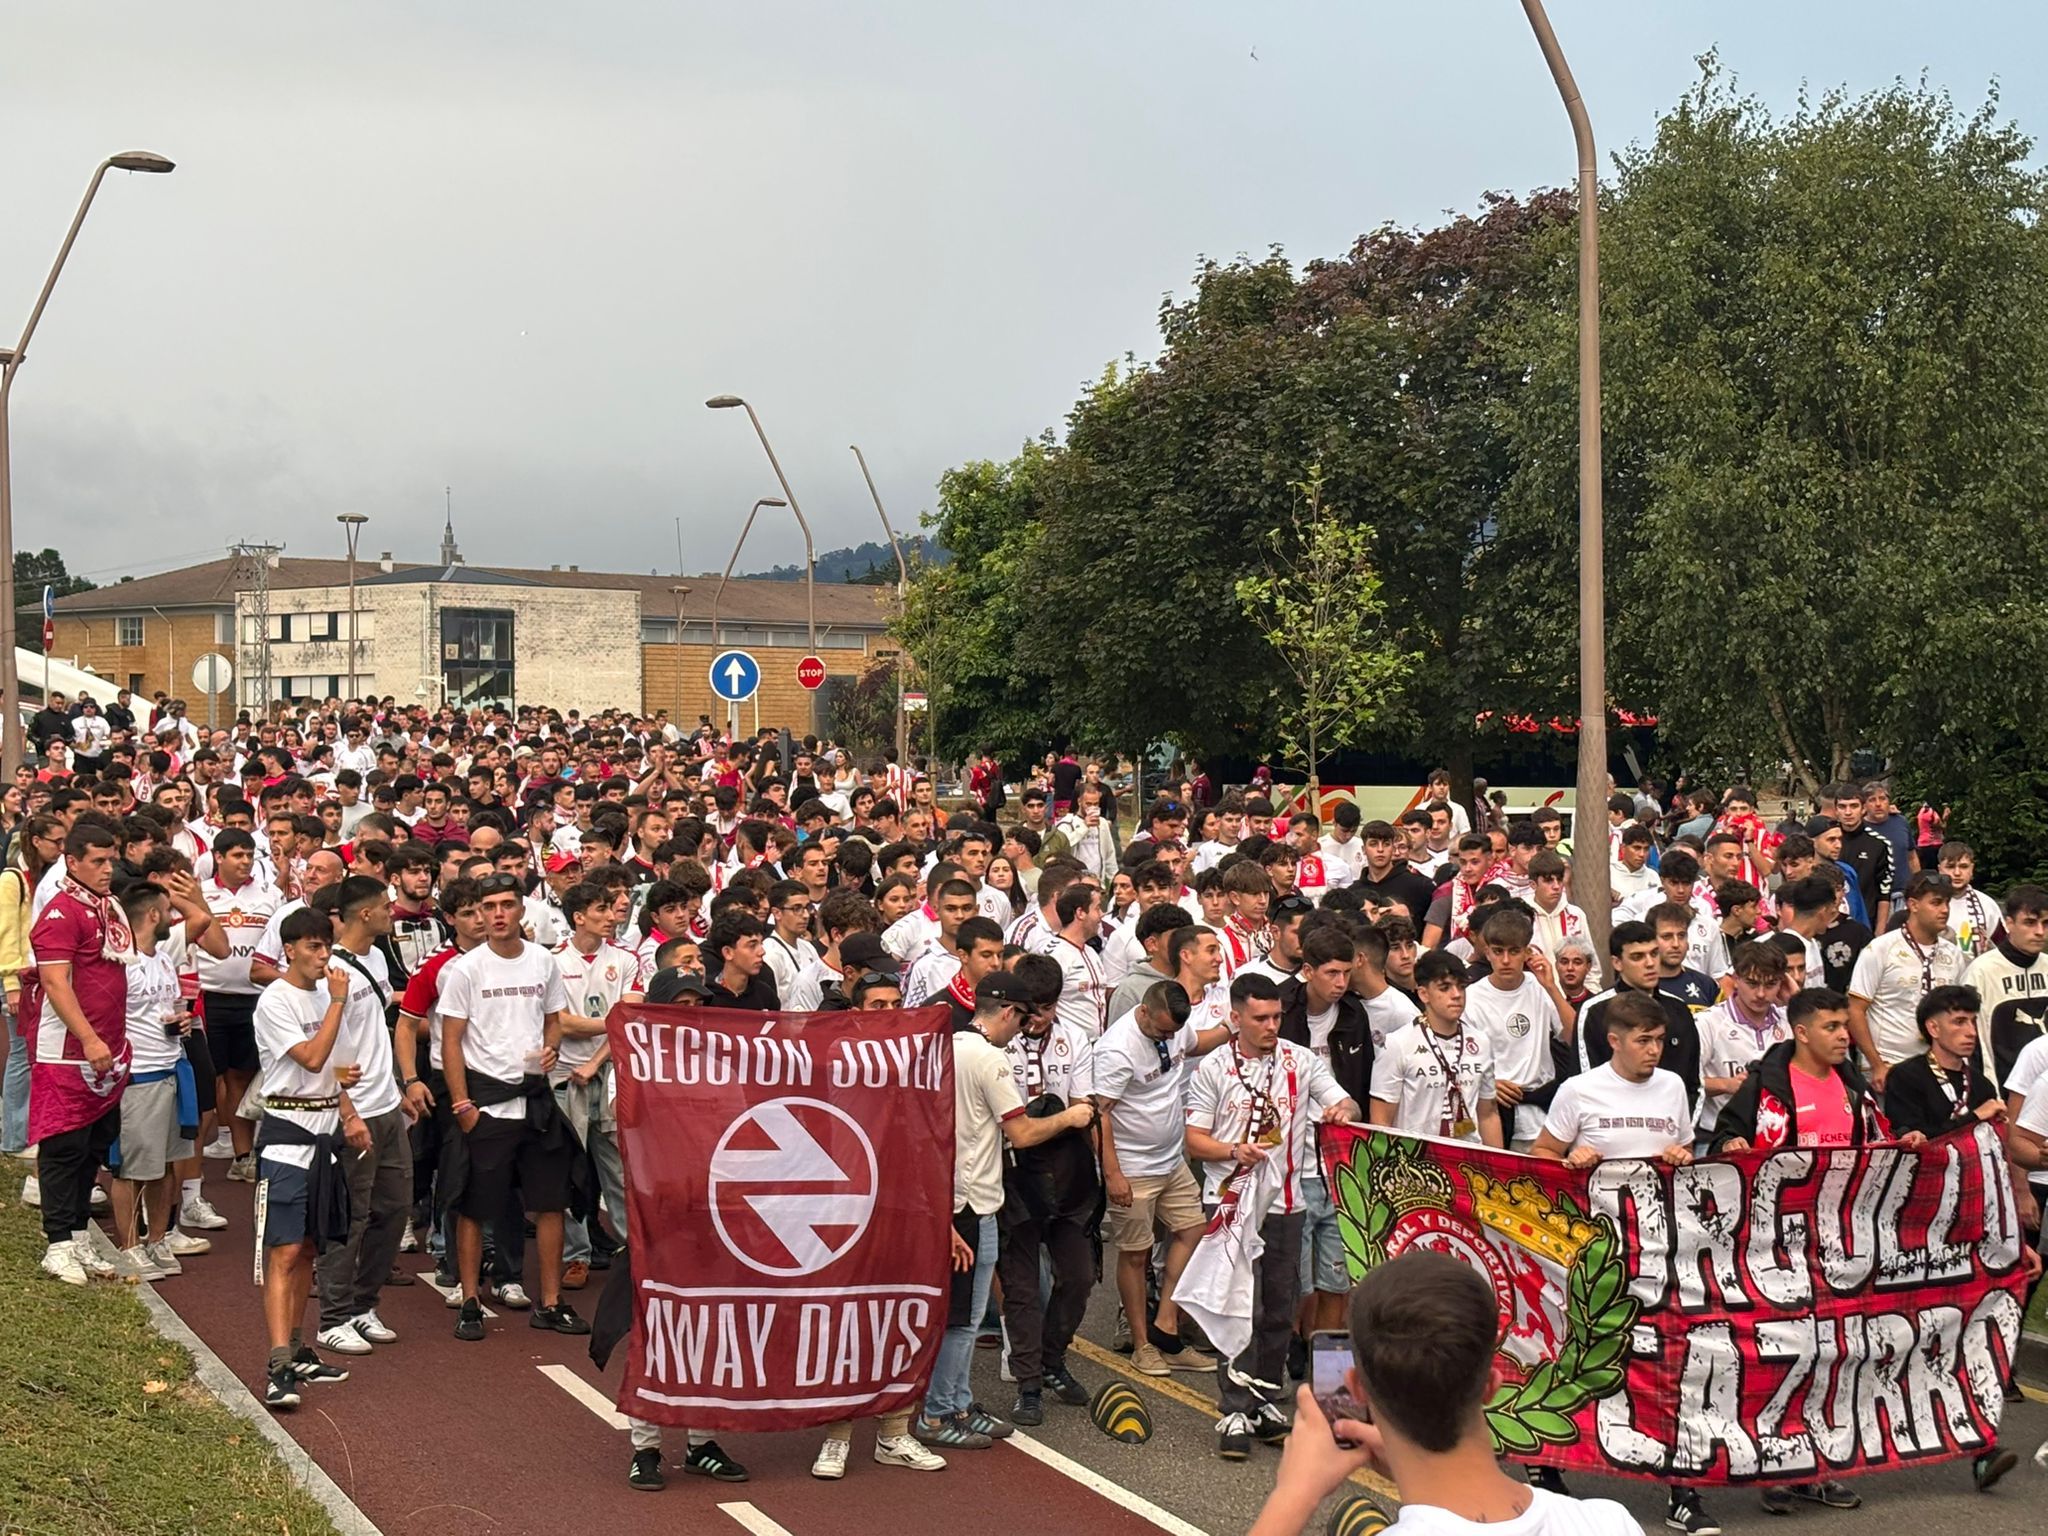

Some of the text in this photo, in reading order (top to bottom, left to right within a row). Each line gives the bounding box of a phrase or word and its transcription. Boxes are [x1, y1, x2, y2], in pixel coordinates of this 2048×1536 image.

[799, 668, 823, 678] STOP
[2002, 973, 2047, 994] PUM
[624, 1020, 944, 1092] SECCIÓN JOVEN
[1588, 1121, 2022, 1309] ORGULLO
[1418, 1214, 1432, 1229] Y
[1438, 1214, 1513, 1316] DEPORTIVA
[645, 1297, 930, 1389] AWAY DAYS
[1597, 1288, 2024, 1476] CAZURRO
